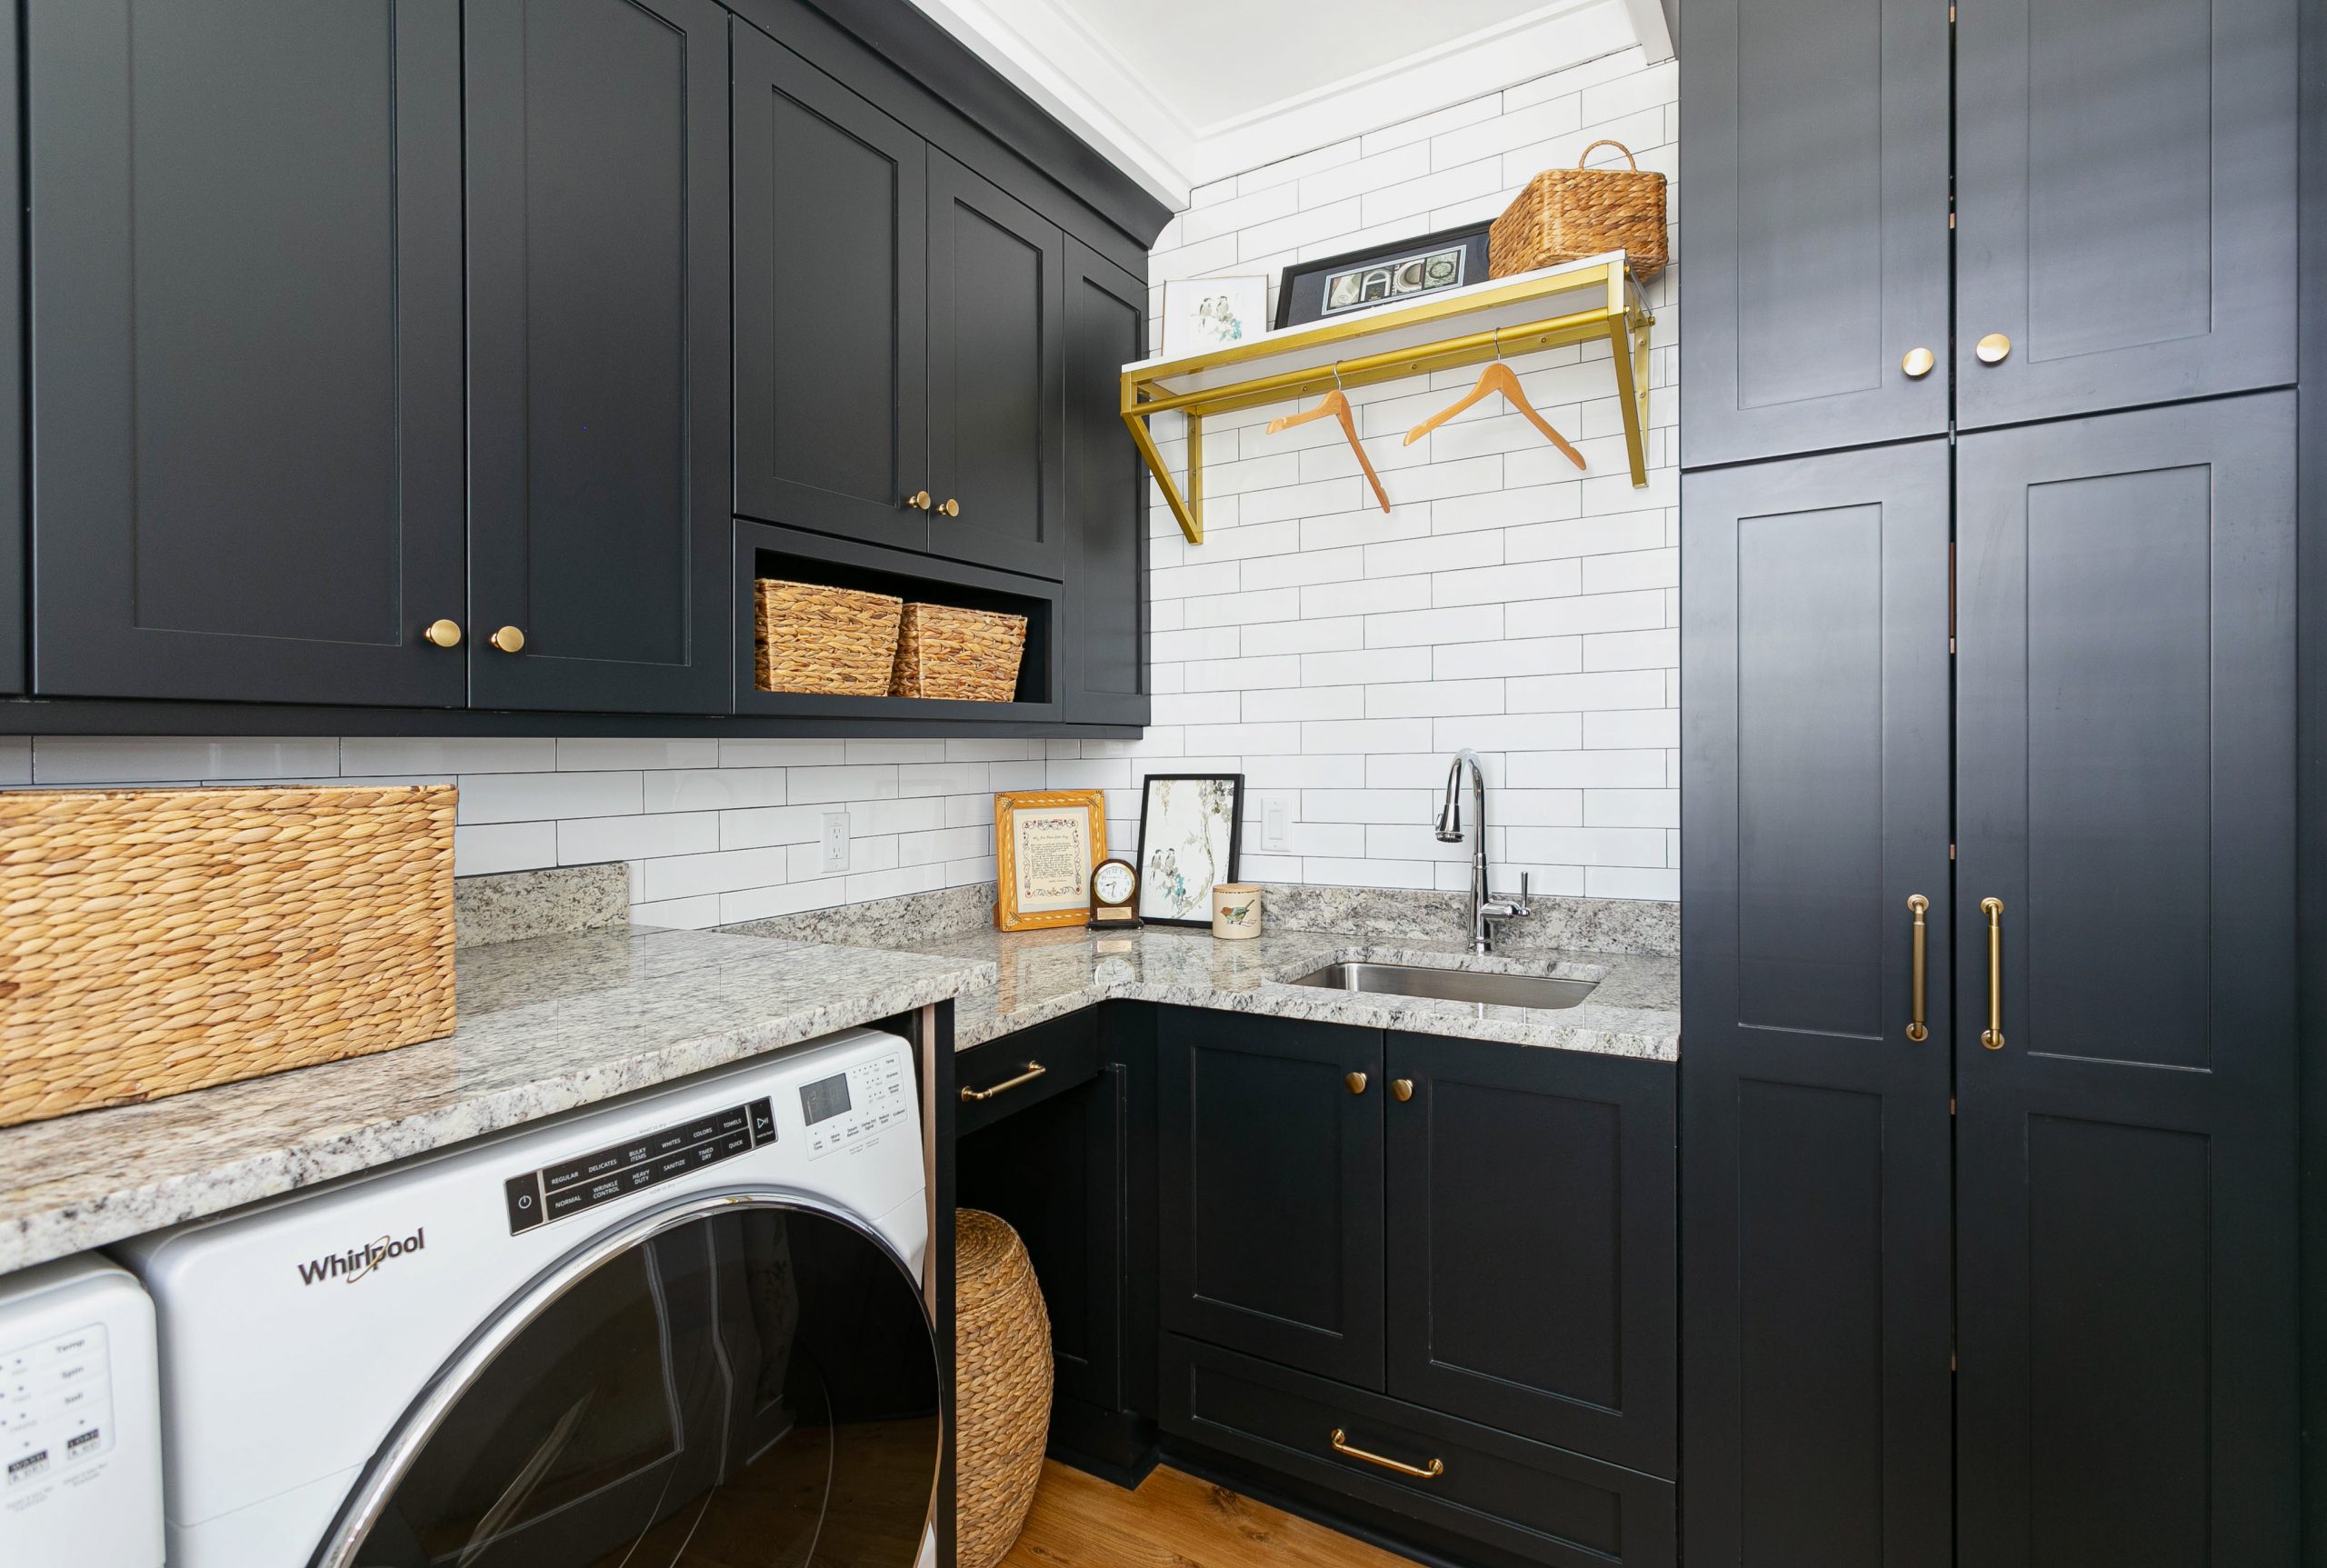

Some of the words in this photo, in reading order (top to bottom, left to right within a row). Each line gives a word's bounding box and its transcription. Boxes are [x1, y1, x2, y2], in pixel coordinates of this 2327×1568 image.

[723, 1118, 742, 1129] TOWELS
[693, 1127, 713, 1138] COLORS
[661, 1138, 682, 1148] WHITES
[728, 1139, 744, 1149] QUICK
[628, 1147, 647, 1158] BULKY
[698, 1147, 714, 1157] TIMED
[702, 1153, 713, 1162] DRY
[630, 1153, 647, 1163] ITEMS
[588, 1159, 617, 1174] DELICATES
[663, 1159, 686, 1172] SANITIZE
[551, 1172, 579, 1185] REGULAR
[632, 1169, 651, 1180] HEAVY
[634, 1176, 650, 1185] DUTY
[593, 1180, 619, 1193] WRINKLE
[593, 1187, 620, 1199] CONTROL
[554, 1195, 582, 1208] NORMAL
[297, 1226, 425, 1287] Whirlpool
